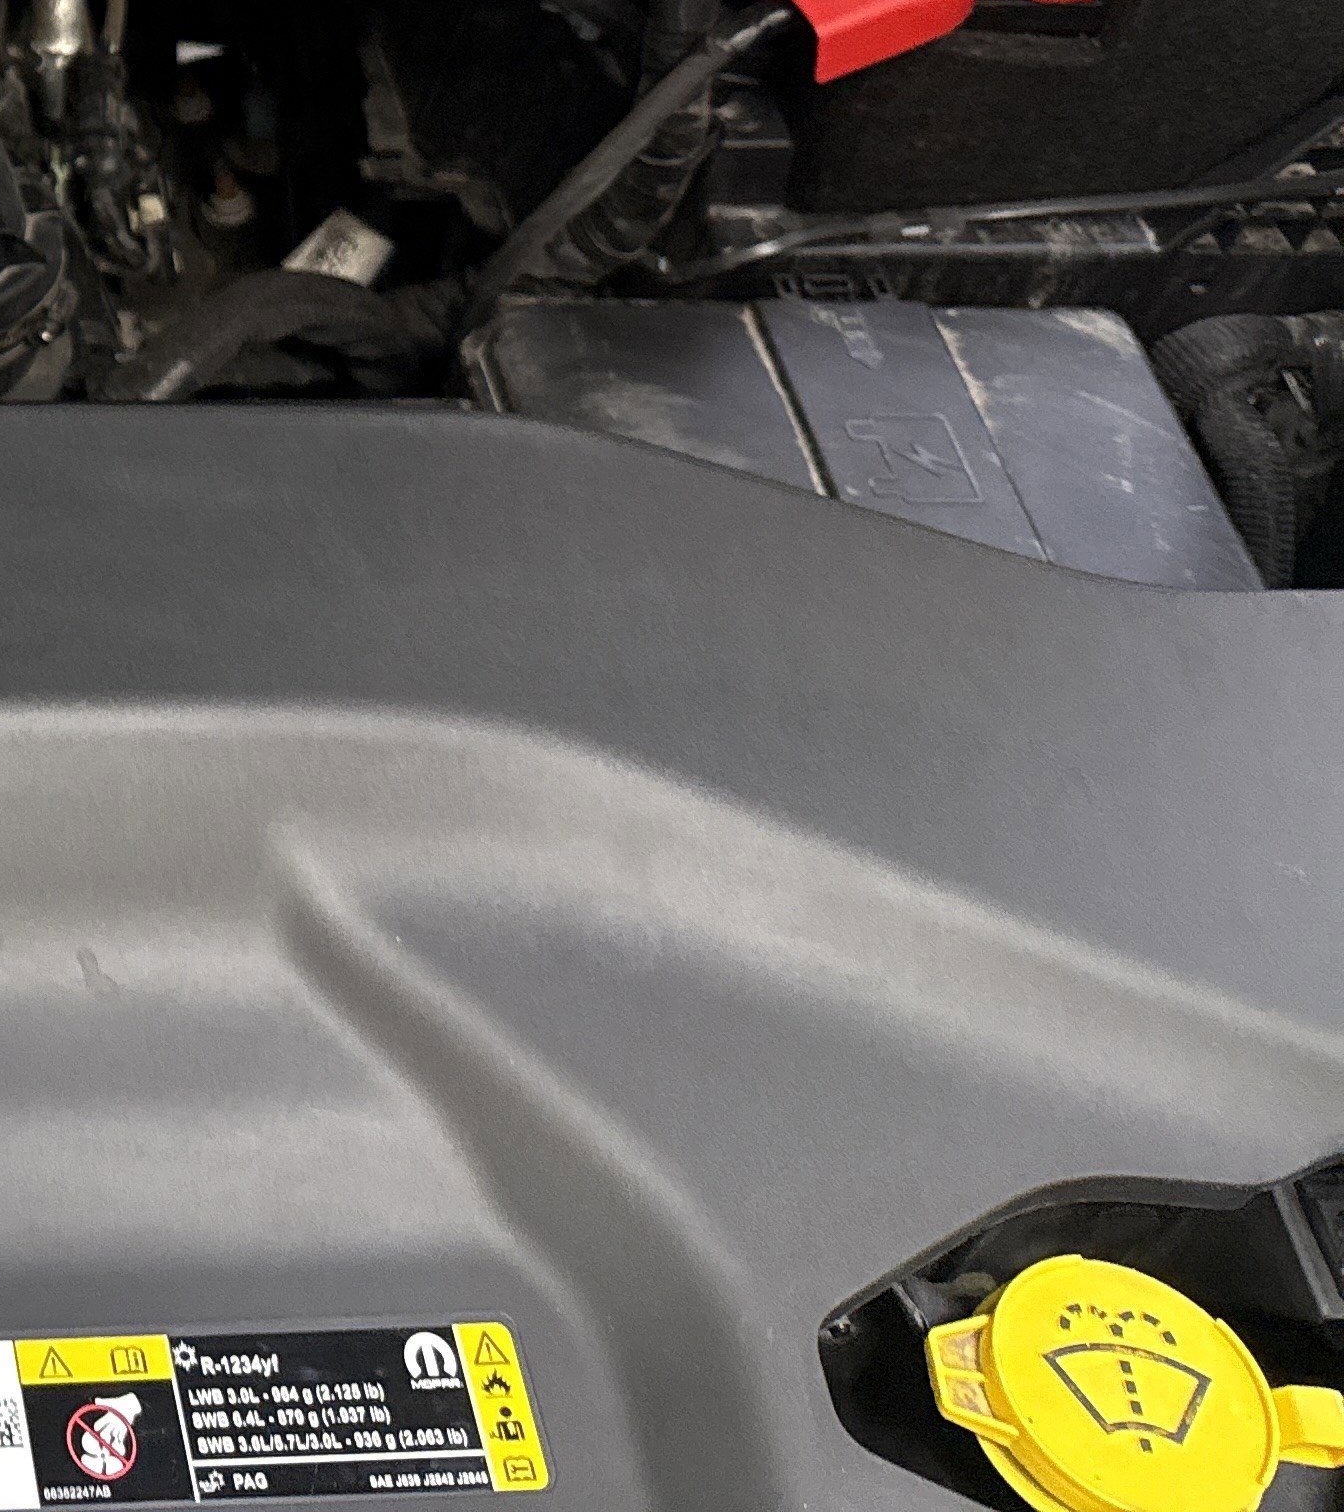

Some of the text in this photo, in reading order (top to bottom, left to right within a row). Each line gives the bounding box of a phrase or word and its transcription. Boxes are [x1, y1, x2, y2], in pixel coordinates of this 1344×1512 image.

[200, 1353, 279, 1377] R-1234yf
[188, 1387, 224, 1406] LWB
[227, 1387, 260, 1405] 3.0L
[364, 1382, 385, 1402] lb)
[369, 1405, 391, 1425] lb)
[446, 1427, 468, 1448] lb)
[232, 1471, 269, 1490] PAG
